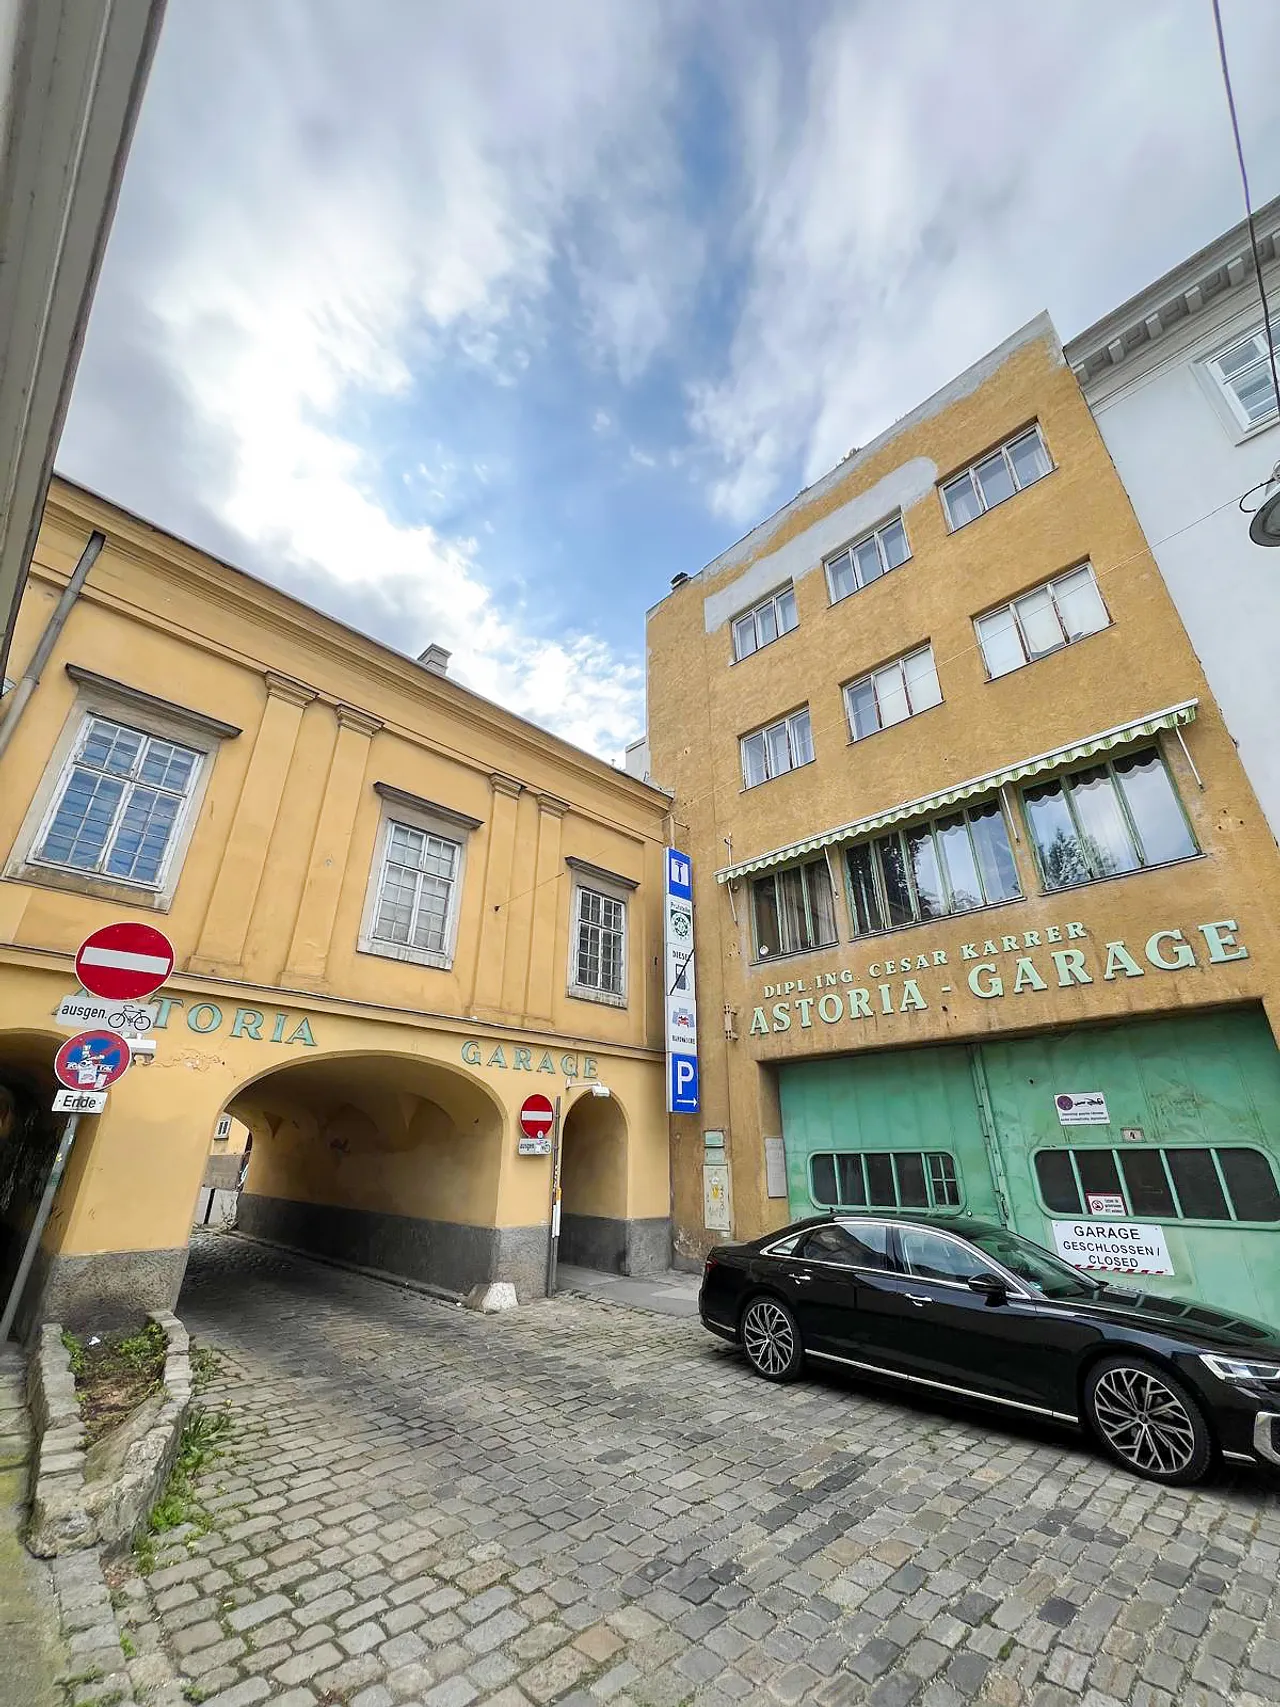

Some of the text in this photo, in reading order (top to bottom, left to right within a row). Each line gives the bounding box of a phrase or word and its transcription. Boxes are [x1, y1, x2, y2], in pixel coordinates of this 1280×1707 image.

[869, 950, 948, 978] CESAR
[961, 921, 1087, 960] KARRER
[749, 979, 928, 1035] ASTORIA
[968, 919, 1249, 999] GARAGE
[61, 1003, 107, 1020] ausgen.
[461, 1040, 599, 1078] GARAGE
[677, 1060, 694, 1095] P
[63, 1095, 96, 1109] Ende
[1074, 1225, 1141, 1240] GARAGE
[1063, 1240, 1155, 1256] GESCHLOSSEN
[1088, 1254, 1139, 1268] CLOSED
